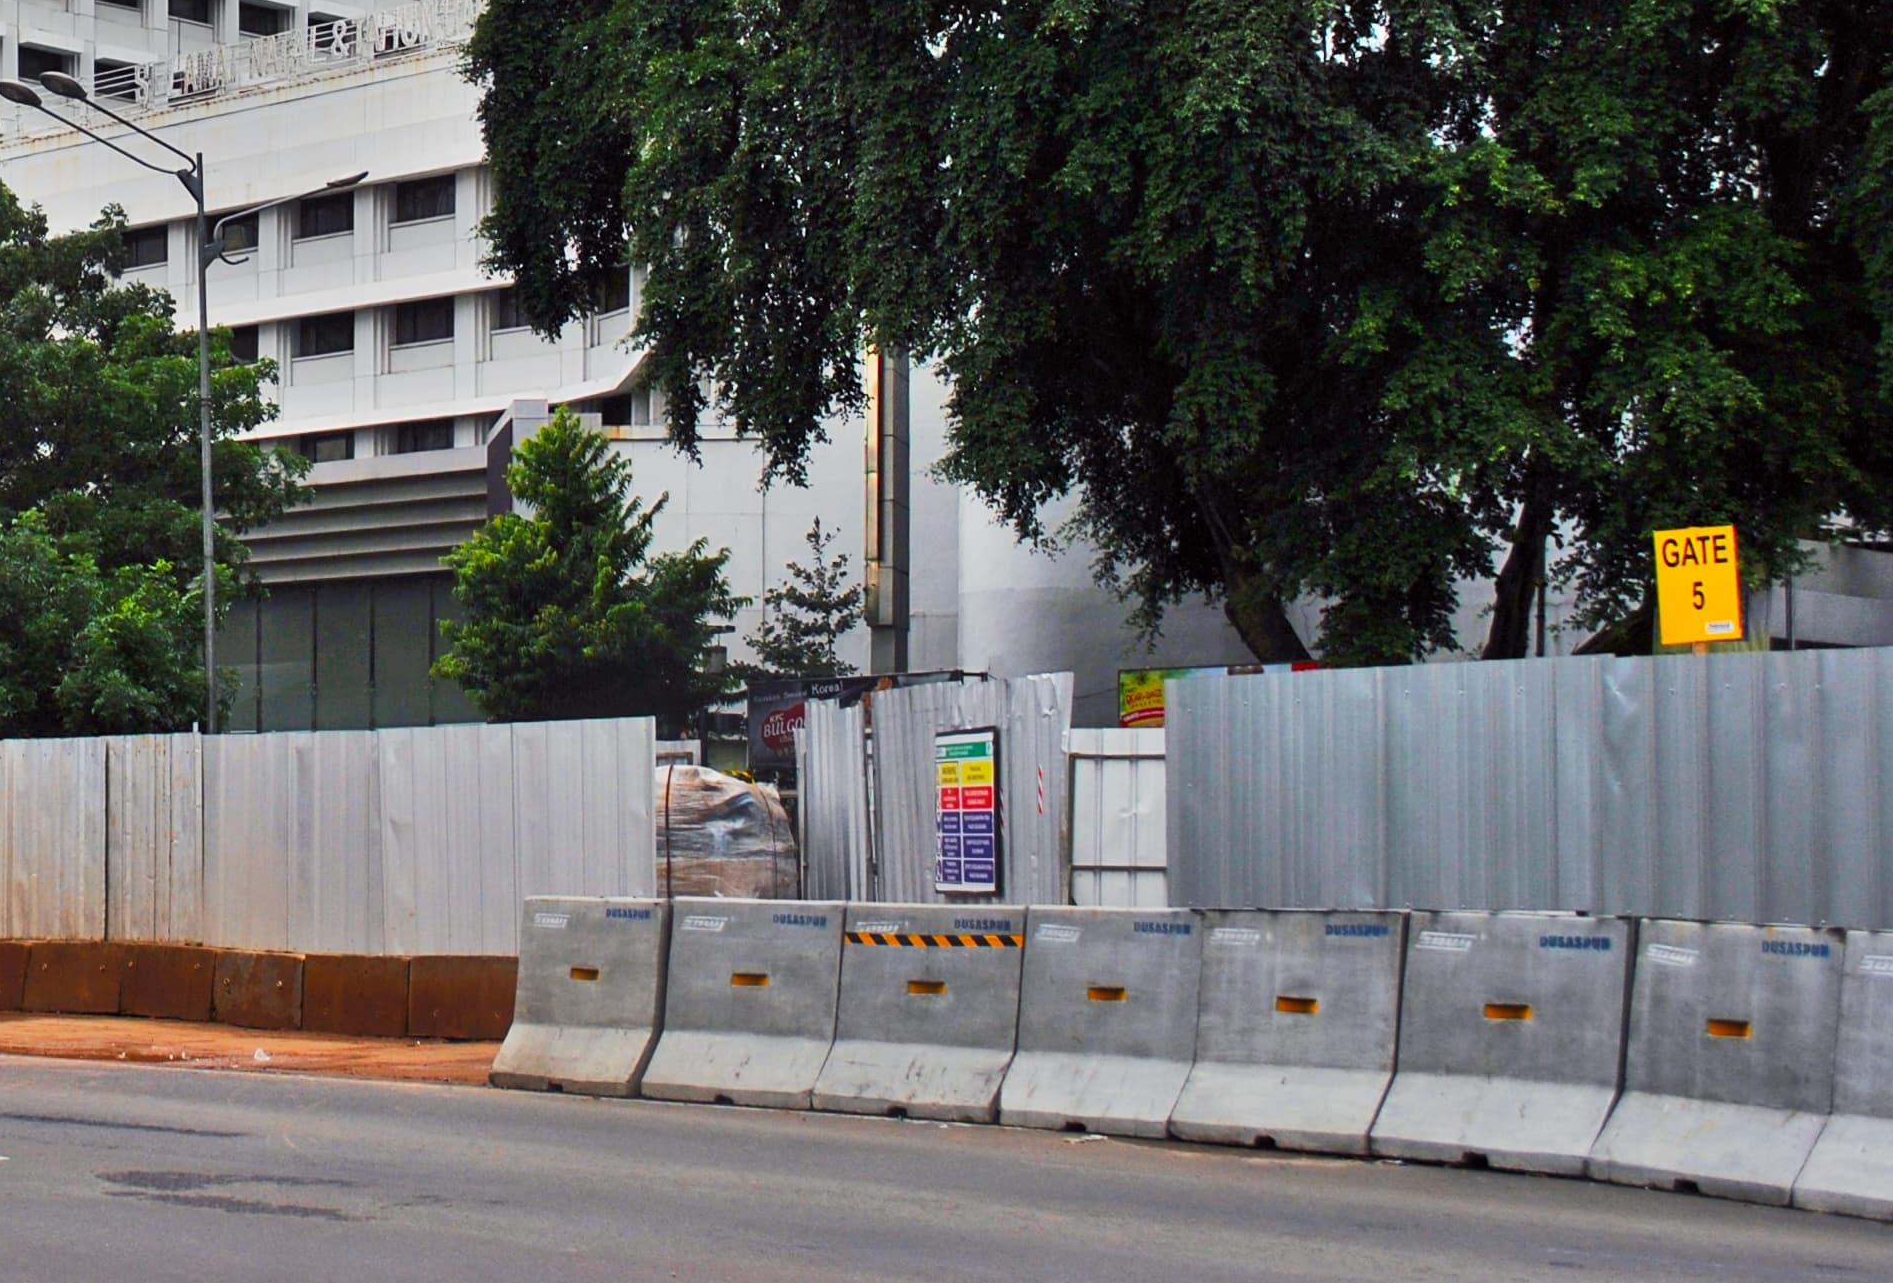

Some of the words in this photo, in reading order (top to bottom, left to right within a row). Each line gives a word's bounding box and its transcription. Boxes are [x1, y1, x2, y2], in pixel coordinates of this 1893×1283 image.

[1662, 534, 1728, 568] GATE
[1692, 581, 1705, 610] 5
[811, 680, 843, 695] Korea!
[763, 717, 805, 737] BULGO
